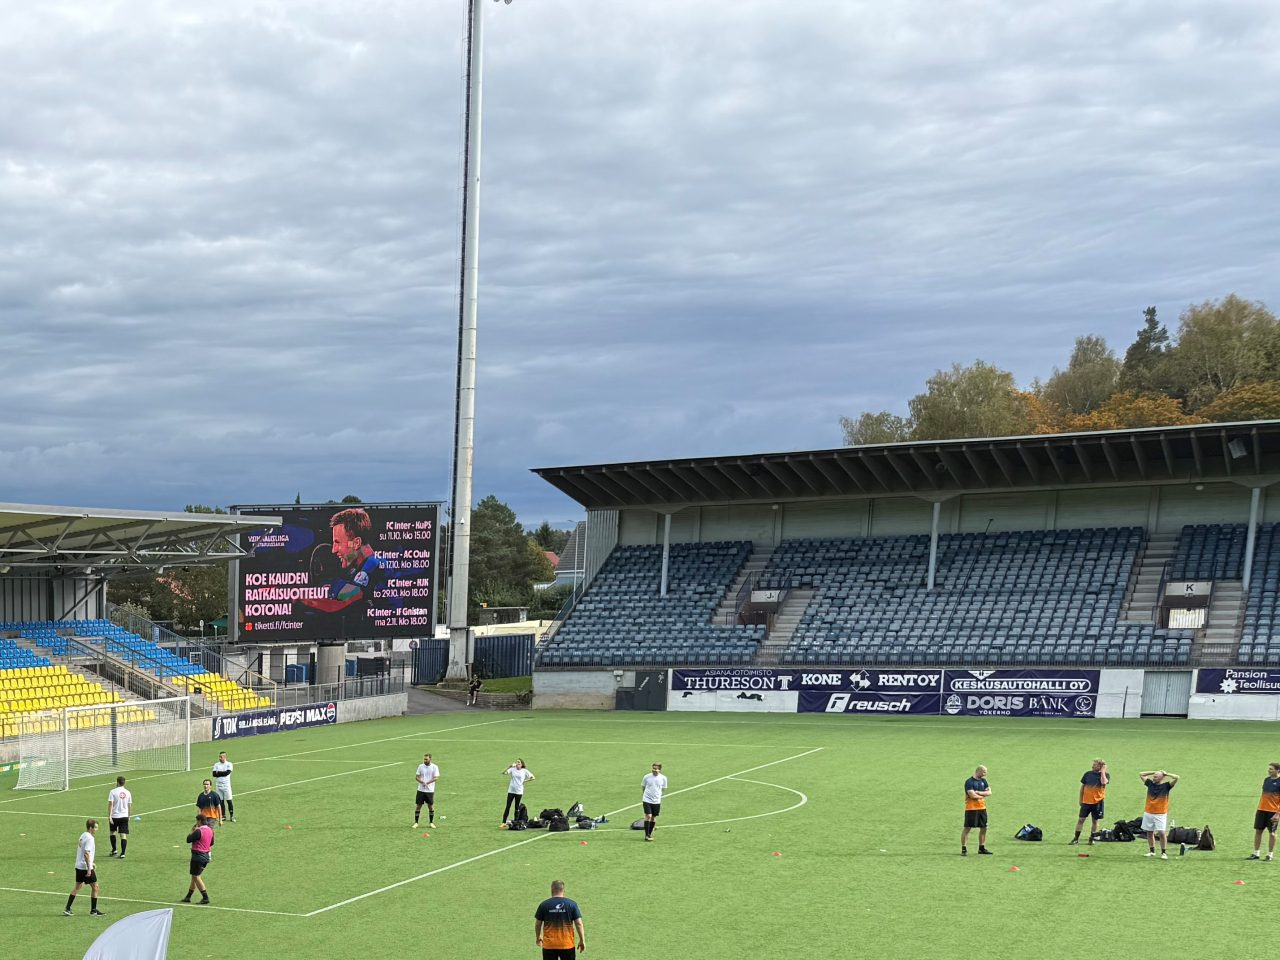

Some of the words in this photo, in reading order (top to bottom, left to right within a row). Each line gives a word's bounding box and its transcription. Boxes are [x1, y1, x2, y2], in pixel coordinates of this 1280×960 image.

[386, 521, 393, 529] FC
[394, 521, 411, 529] Inter
[414, 531, 431, 540] 15.00
[374, 551, 382, 559] FC
[382, 551, 399, 559] Inter
[403, 550, 413, 559] AC
[413, 550, 430, 558] Oulu
[245, 573, 267, 585] KOE
[268, 572, 309, 585] KAUDEN
[387, 579, 395, 587] FC
[395, 579, 413, 587] Inter
[411, 588, 429, 597] 18.00
[1185, 583, 1195, 592] K
[245, 587, 330, 601] RATKAISUOTTELUT
[245, 603, 292, 616] KOTONA!
[367, 608, 375, 617] FC
[375, 608, 392, 617] Inter
[402, 607, 428, 616] Gnistan
[410, 617, 428, 625] 18.00
[1225, 669, 1268, 679] Pansion
[684, 676, 776, 689] THURESON
[801, 673, 842, 686] KONE
[954, 680, 1066, 690] KESKUSAUTOHALLI
[1069, 681, 1087, 690] OY
[848, 698, 911, 711] reusch
[966, 695, 1024, 710] DORIS
[1029, 695, 1070, 712] BÄNK
[279, 710, 305, 728] PEPSI
[306, 707, 327, 723] MAX
